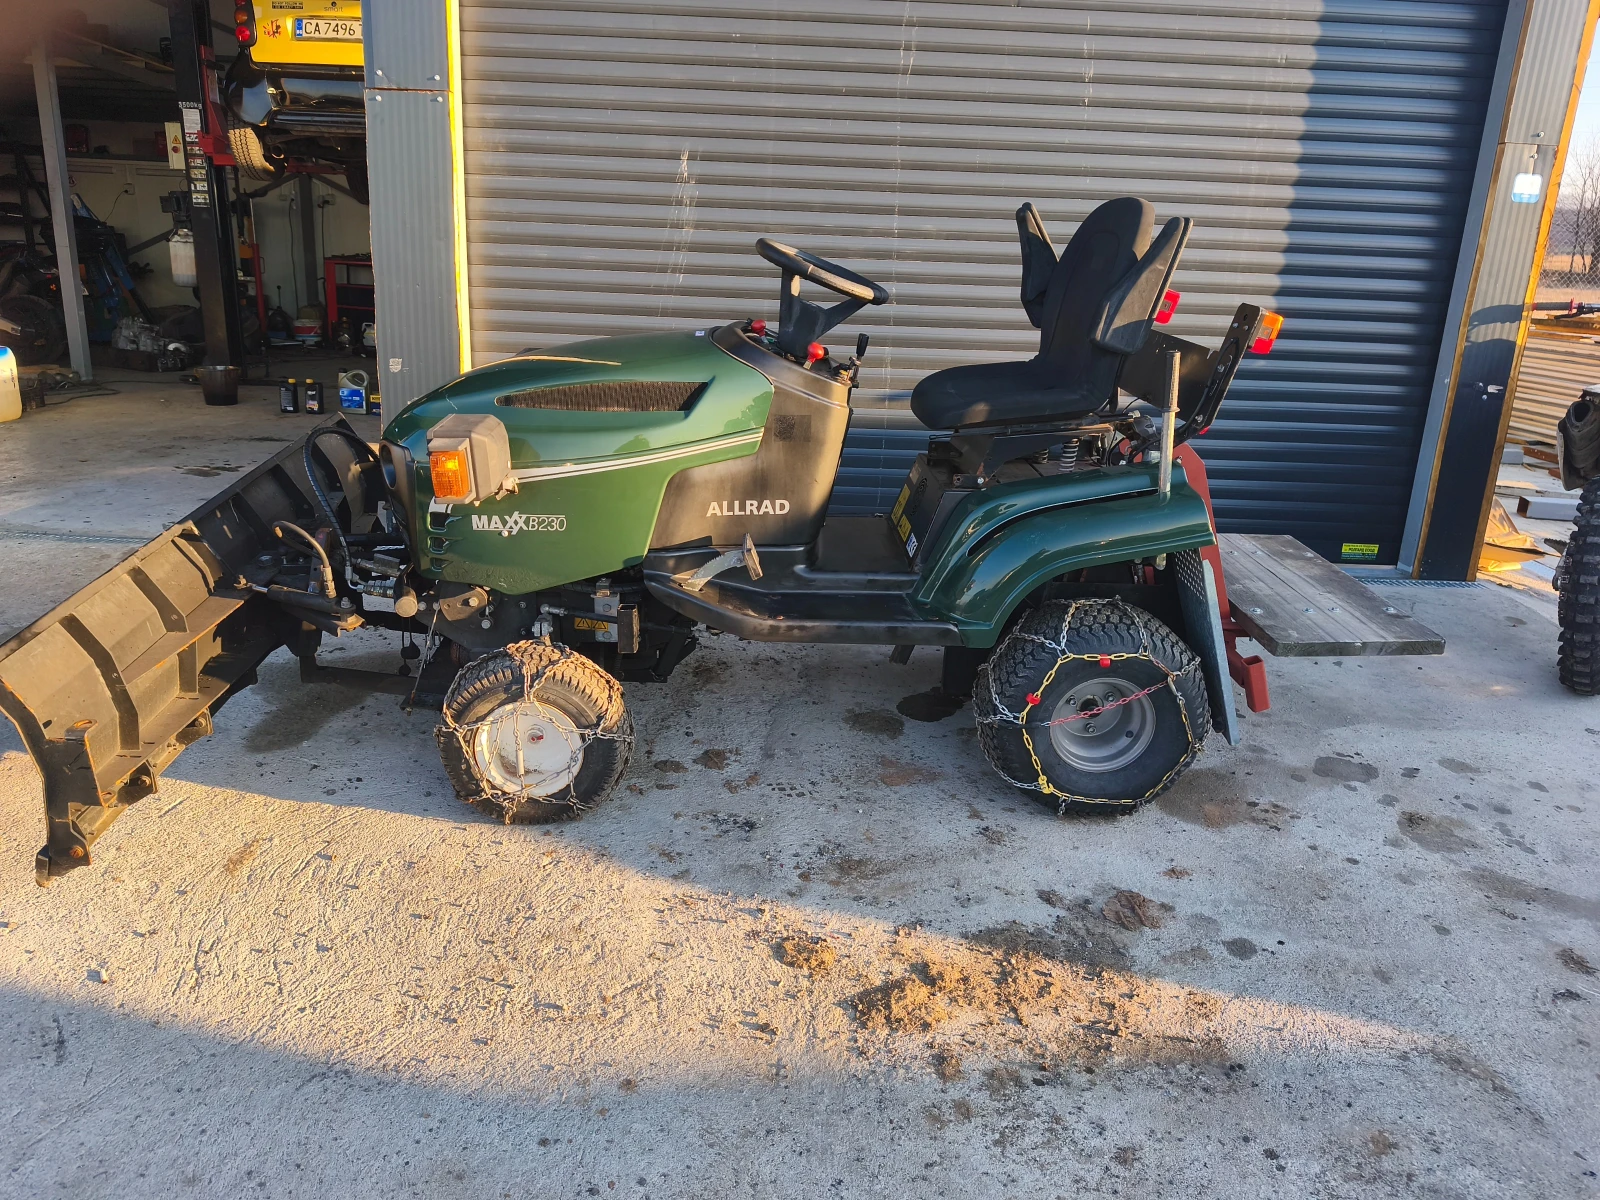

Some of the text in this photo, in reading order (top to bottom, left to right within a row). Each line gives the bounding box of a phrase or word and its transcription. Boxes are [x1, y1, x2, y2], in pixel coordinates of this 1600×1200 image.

[304, 22, 321, 35] CA
[324, 22, 355, 36] 7496
[706, 499, 790, 517] ALLRAD
